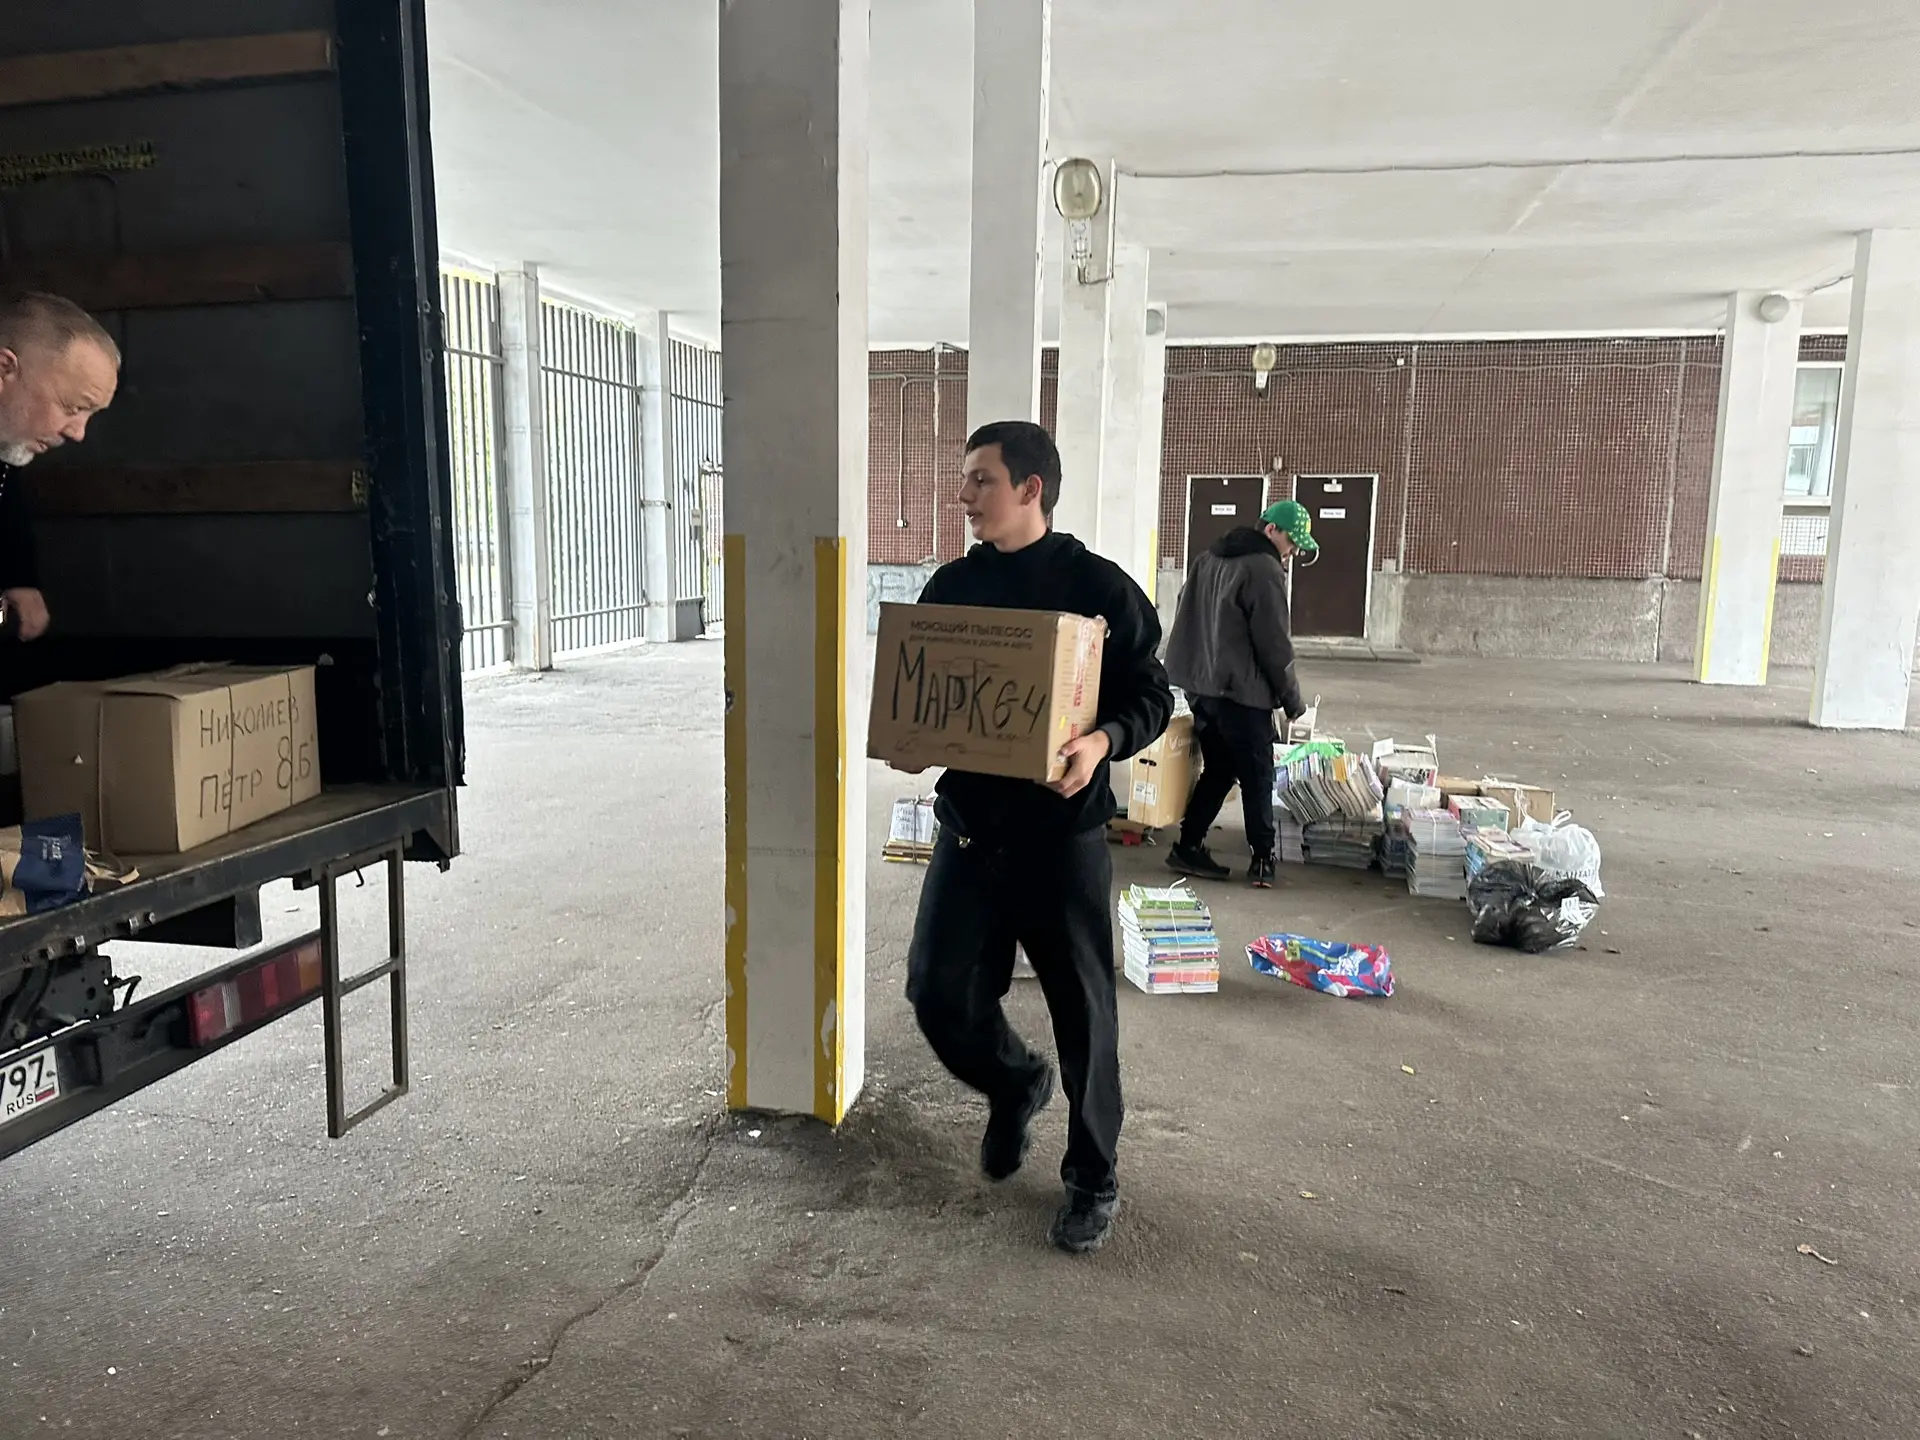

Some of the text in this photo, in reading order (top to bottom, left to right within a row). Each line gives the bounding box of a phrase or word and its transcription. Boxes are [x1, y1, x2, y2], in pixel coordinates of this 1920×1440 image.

[910, 620, 1034, 639] МОЮЩИЙ ПЫЛЕСОС
[6, 1093, 34, 1115] RUS
